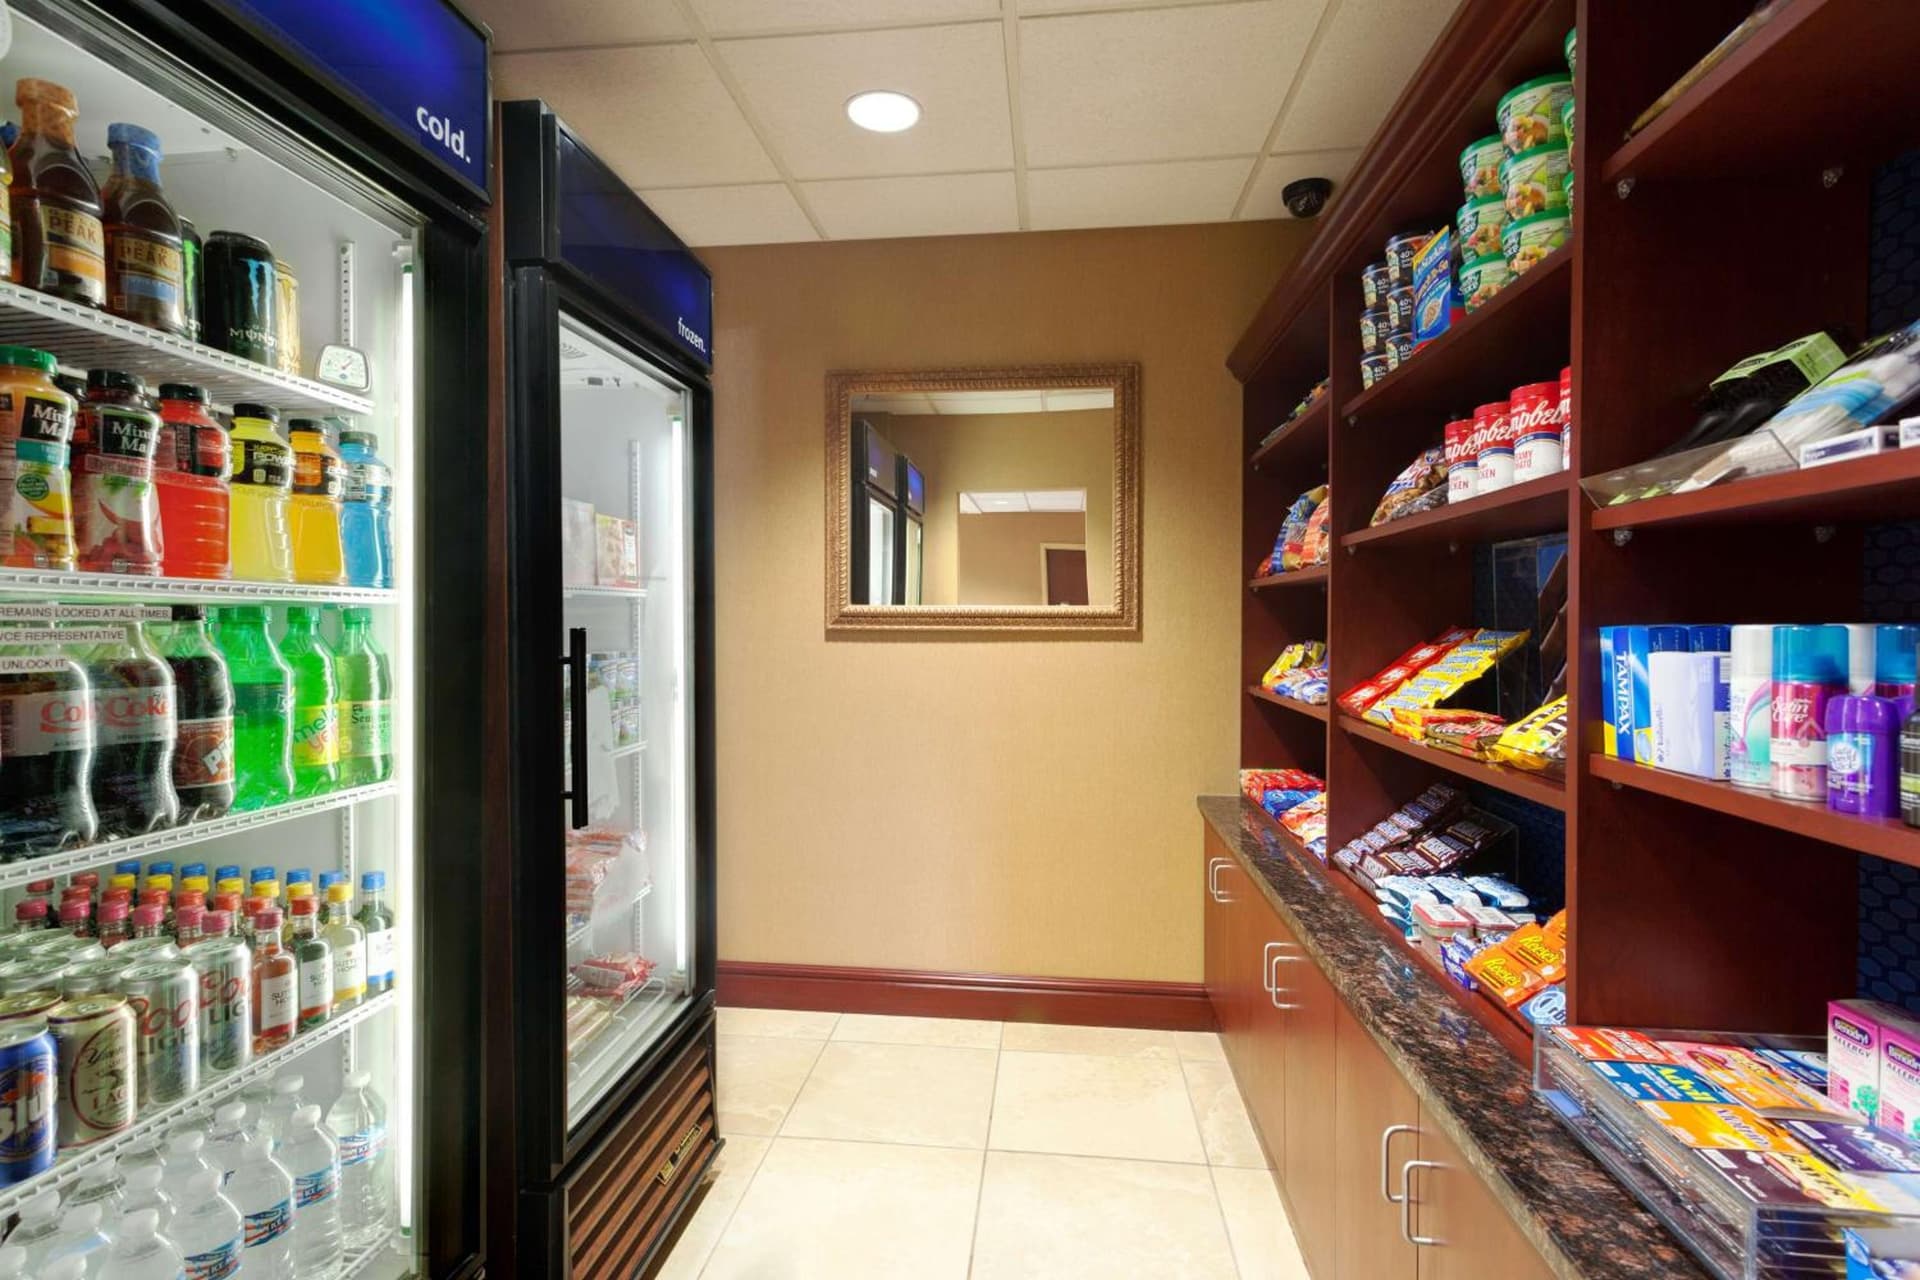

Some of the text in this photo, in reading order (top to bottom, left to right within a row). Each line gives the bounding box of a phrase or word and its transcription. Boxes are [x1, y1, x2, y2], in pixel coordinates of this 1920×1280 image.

[416, 106, 471, 164] cold.
[678, 316, 706, 353] frozen.
[55, 608, 100, 618] LOCKED
[103, 608, 117, 617] AT
[119, 608, 137, 618] ALL
[140, 609, 169, 618] TIMES
[25, 629, 124, 641] REPRESENTATIVE
[3, 658, 65, 669] UNLOCK IT
[1615, 651, 1631, 735] TAMPAX
[1833, 1035, 1870, 1058] ALLERGY
